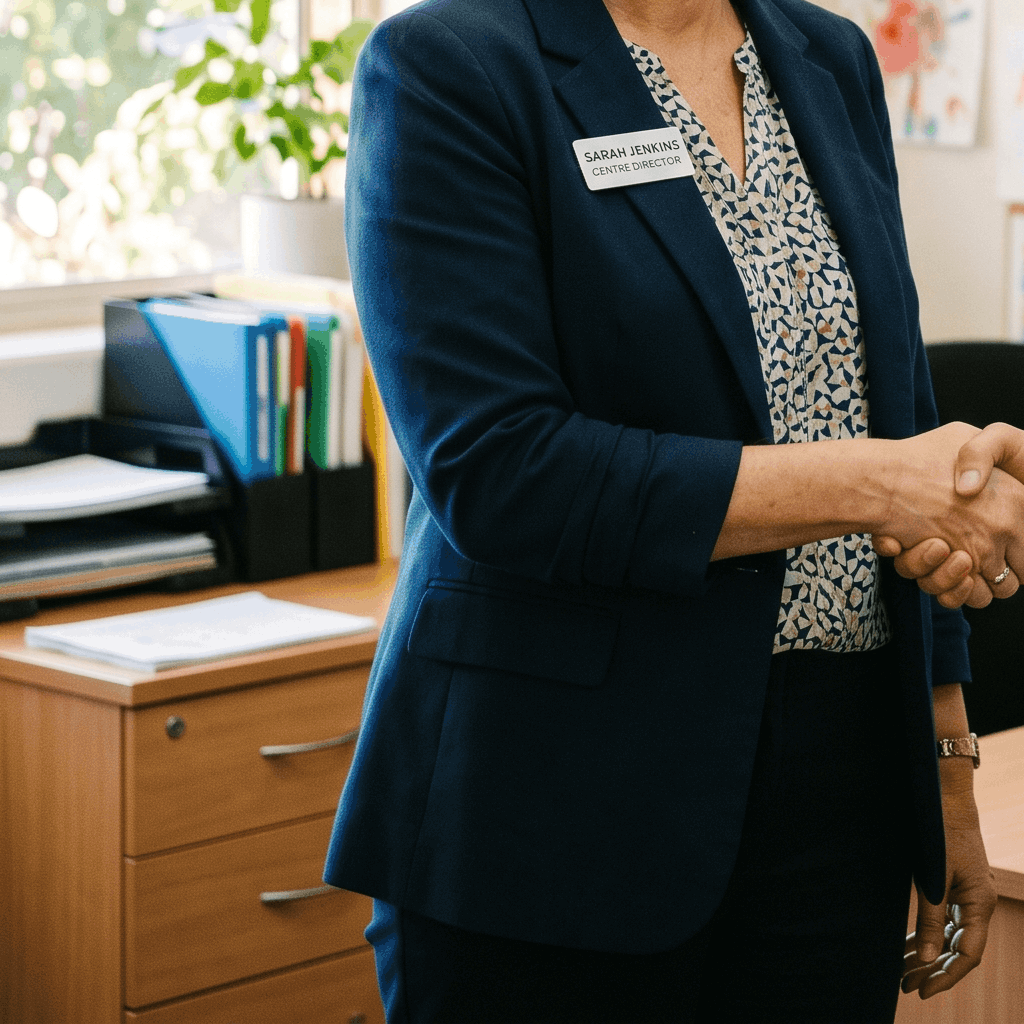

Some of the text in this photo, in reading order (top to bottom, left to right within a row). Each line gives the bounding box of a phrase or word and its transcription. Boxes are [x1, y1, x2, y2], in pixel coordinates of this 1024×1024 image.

[584, 139, 680, 163] SARAH JENKINS
[592, 155, 682, 176] CENTRE DIRECTOR
